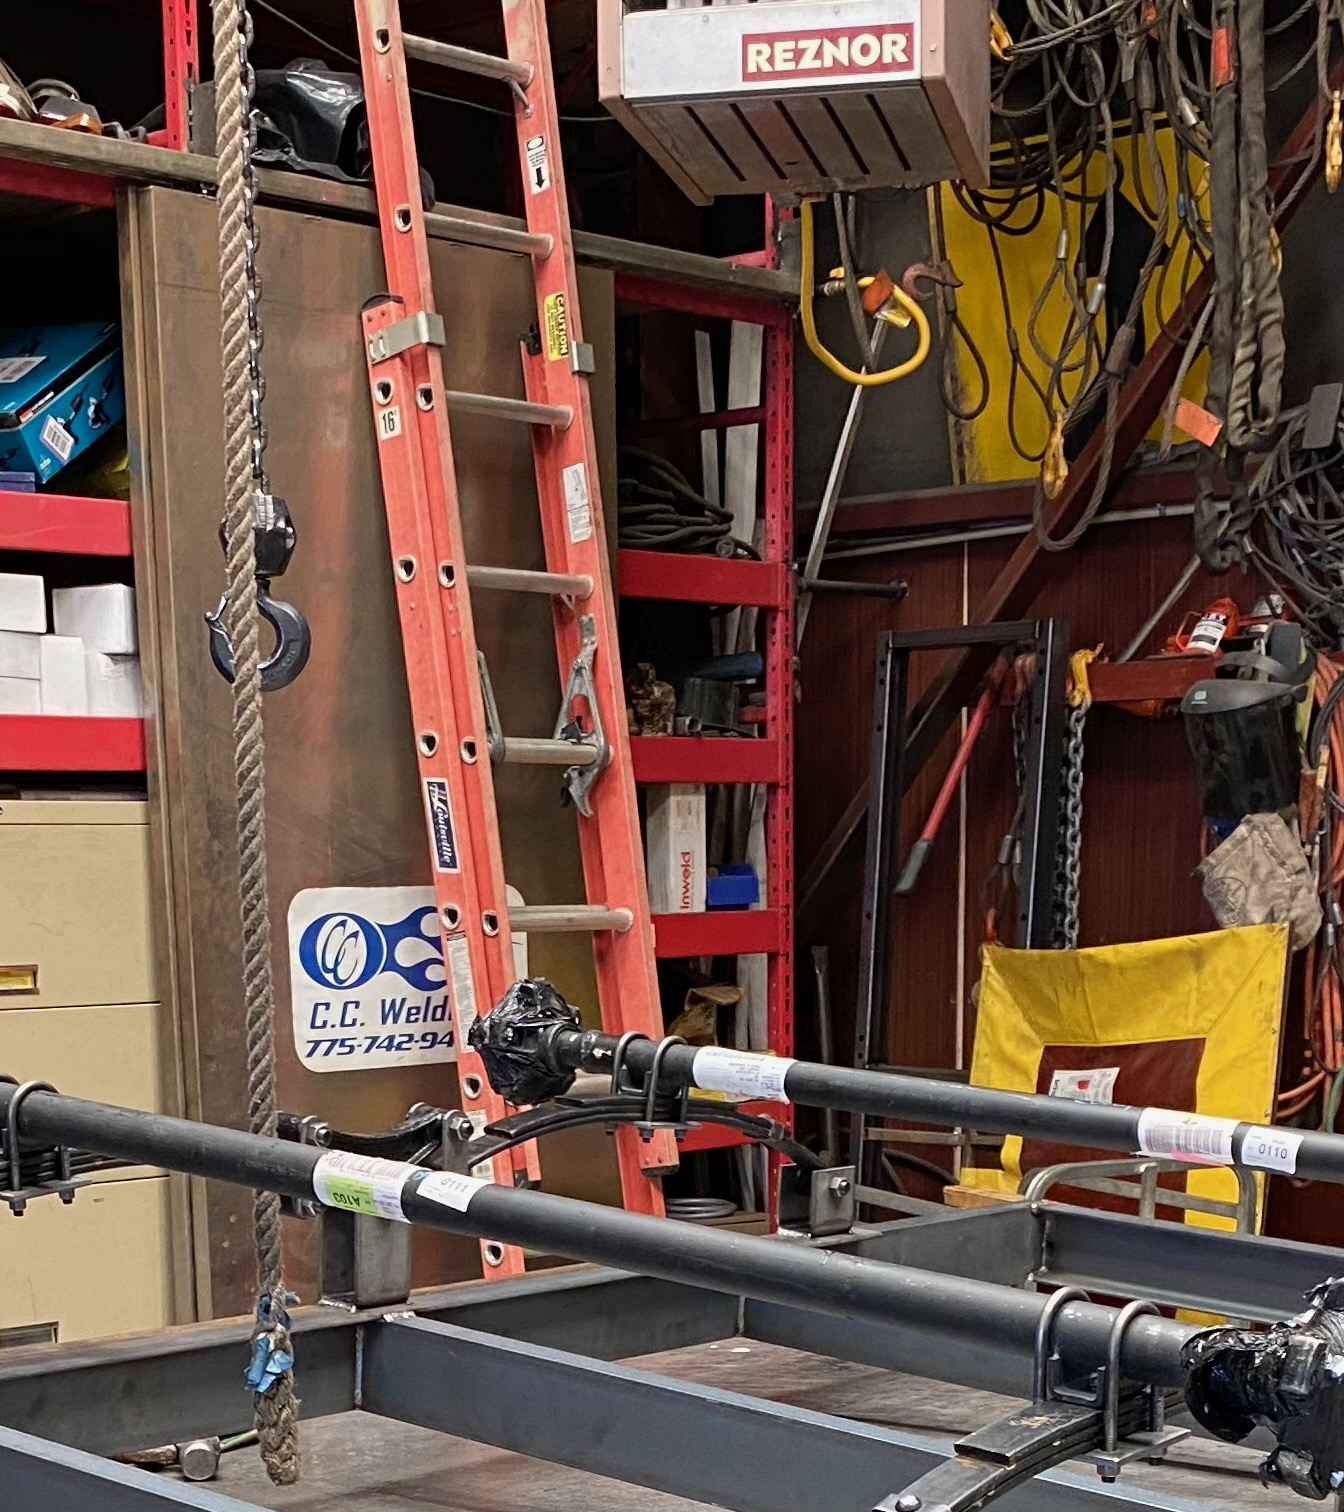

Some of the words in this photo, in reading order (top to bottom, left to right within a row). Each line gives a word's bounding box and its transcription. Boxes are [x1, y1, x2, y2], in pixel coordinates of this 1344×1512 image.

[747, 33, 909, 73] REZNOR
[556, 293, 571, 357] CAUTION
[432, 797, 453, 863] Louisville
[310, 1000, 365, 1030] C.C.
[381, 995, 453, 1026] Weld
[304, 1031, 455, 1059] 775-742-94
[1259, 1143, 1288, 1160] 0110
[333, 1192, 360, 1207] A103
